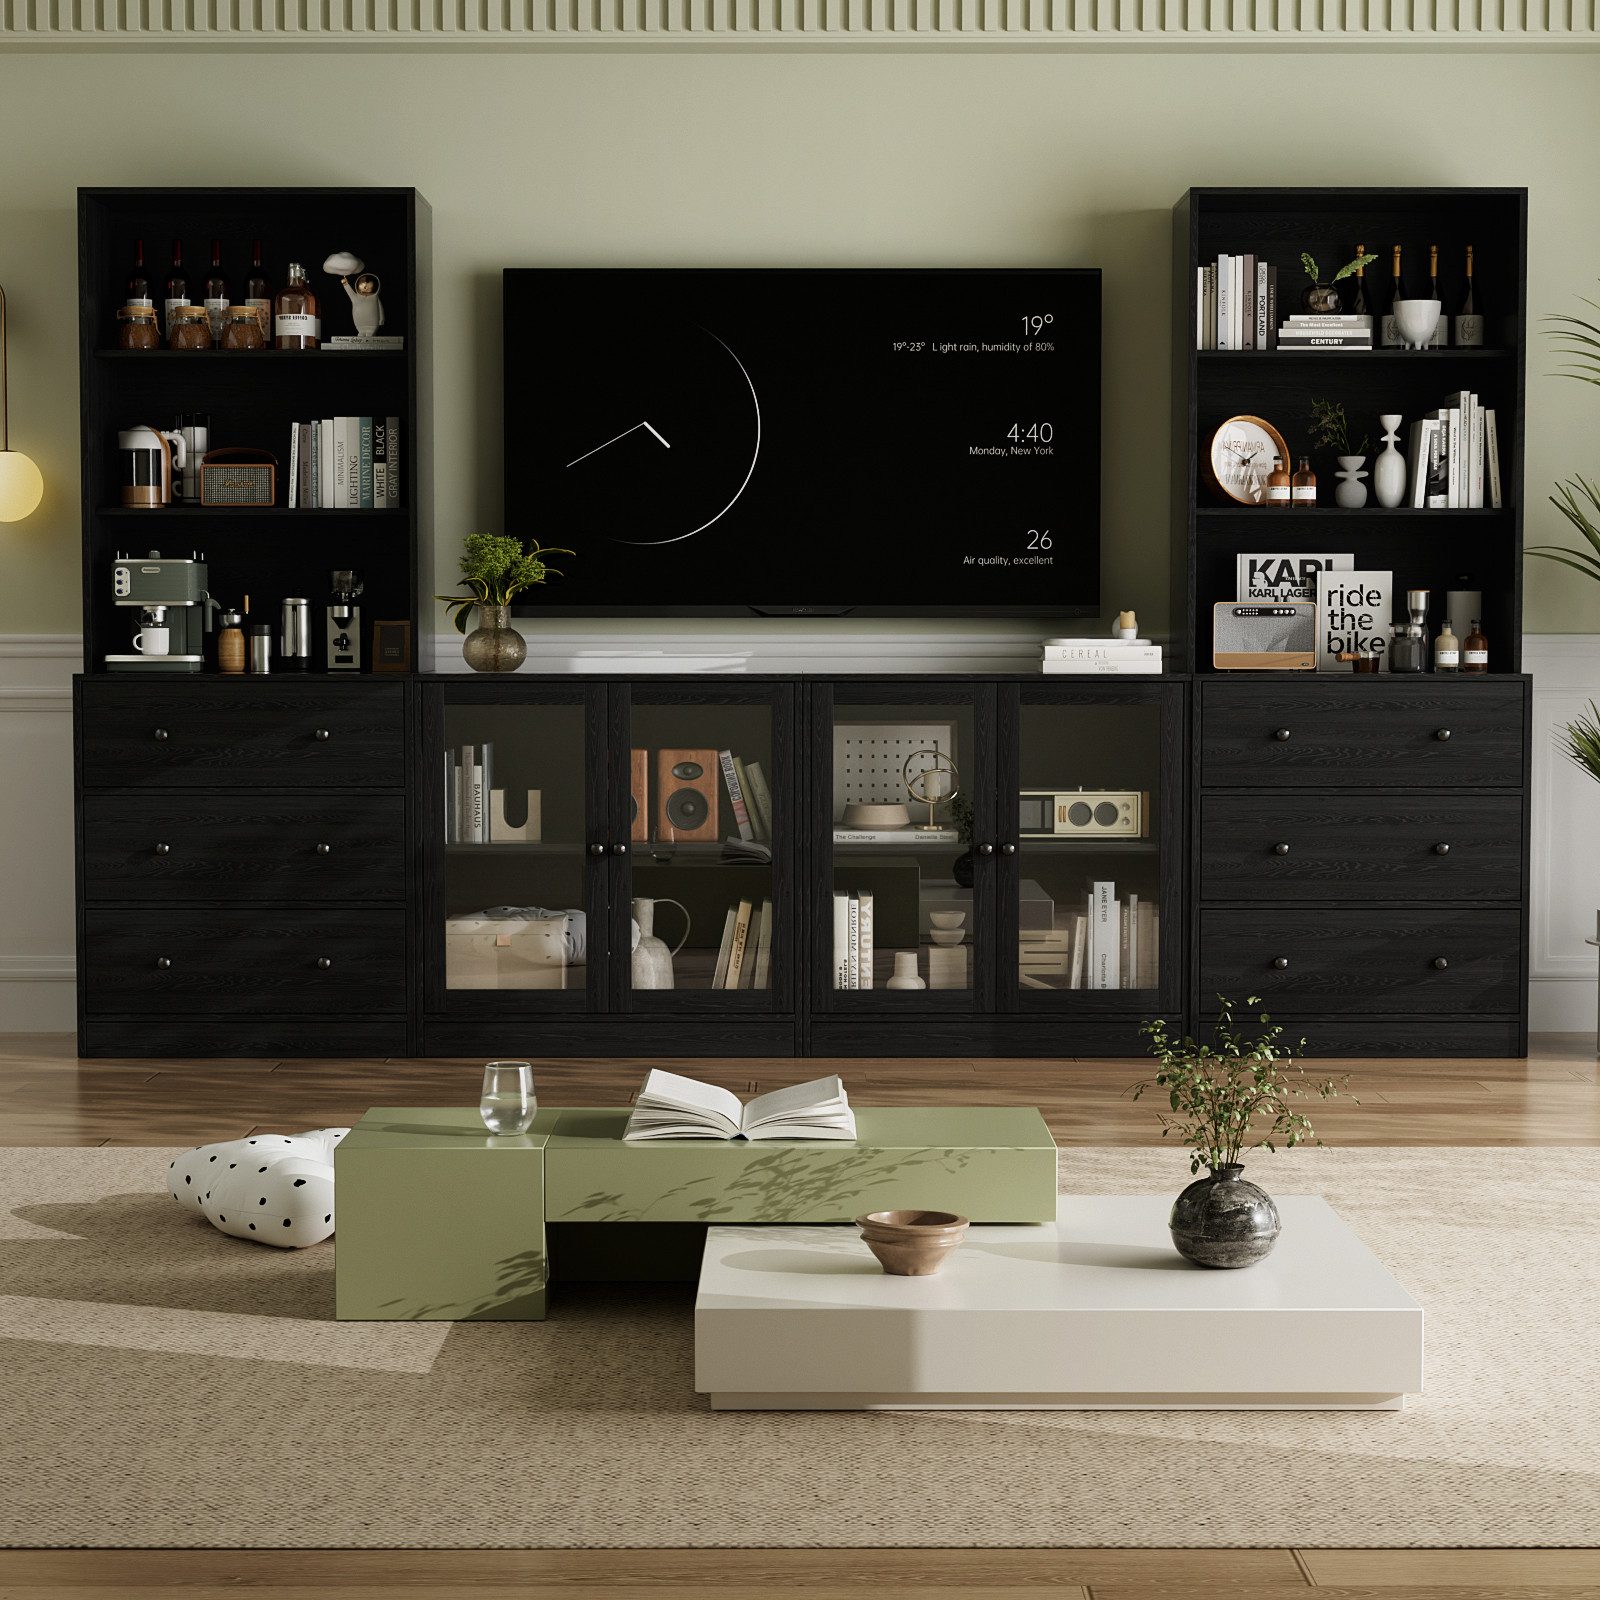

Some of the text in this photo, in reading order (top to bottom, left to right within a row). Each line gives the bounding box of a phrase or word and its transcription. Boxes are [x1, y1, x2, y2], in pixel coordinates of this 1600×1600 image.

[1258, 295, 1266, 337] PORTLAND
[959, 342, 980, 353] rain,
[981, 342, 1021, 354] humidity
[1023, 342, 1033, 352] of
[1034, 342, 1055, 352] 80%
[1006, 422, 1053, 443] 4:40
[361, 426, 371, 500] MARINE DECOR
[375, 425, 385, 498] WHITE BLACK
[388, 427, 398, 498] GRAY INTERIOR
[969, 446, 1054, 457] Monday, New York
[337, 441, 345, 486] MINIMALISM
[349, 455, 359, 505] LIGHTING
[1026, 529, 1053, 550] 26
[963, 555, 1054, 567] Air quality, excellent
[1248, 588, 1278, 598] KARL
[1327, 583, 1382, 607] ride
[1327, 607, 1374, 631] the
[1061, 649, 1109, 659] CEREAL
[1326, 631, 1386, 654] bike
[474, 783, 482, 829] BAUHAUS
[847, 834, 876, 842] Challenge
